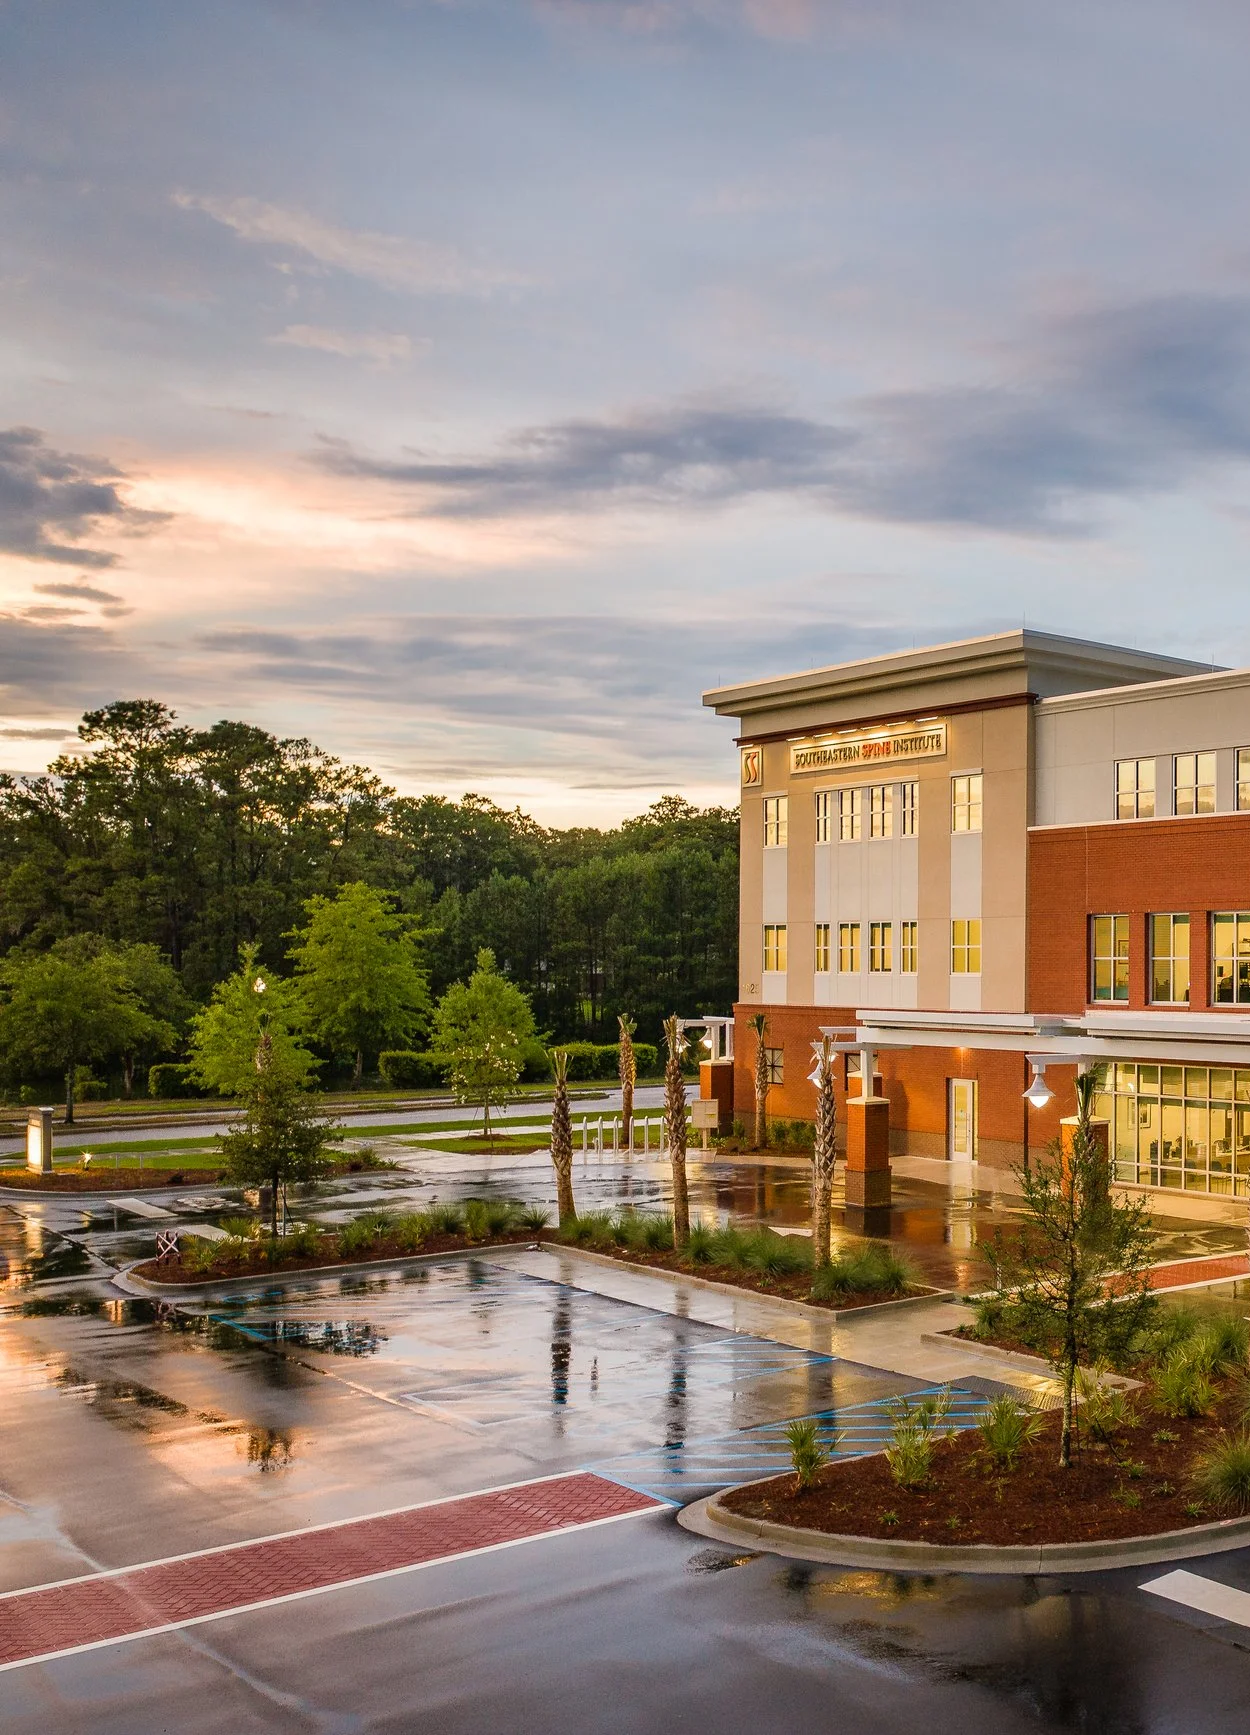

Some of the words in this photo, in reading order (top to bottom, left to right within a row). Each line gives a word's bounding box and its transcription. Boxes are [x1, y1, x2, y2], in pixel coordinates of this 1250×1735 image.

[795, 745, 860, 767] SOUTHEASTERN
[862, 741, 891, 757] SPINE
[893, 734, 941, 753] INSTITUTE
